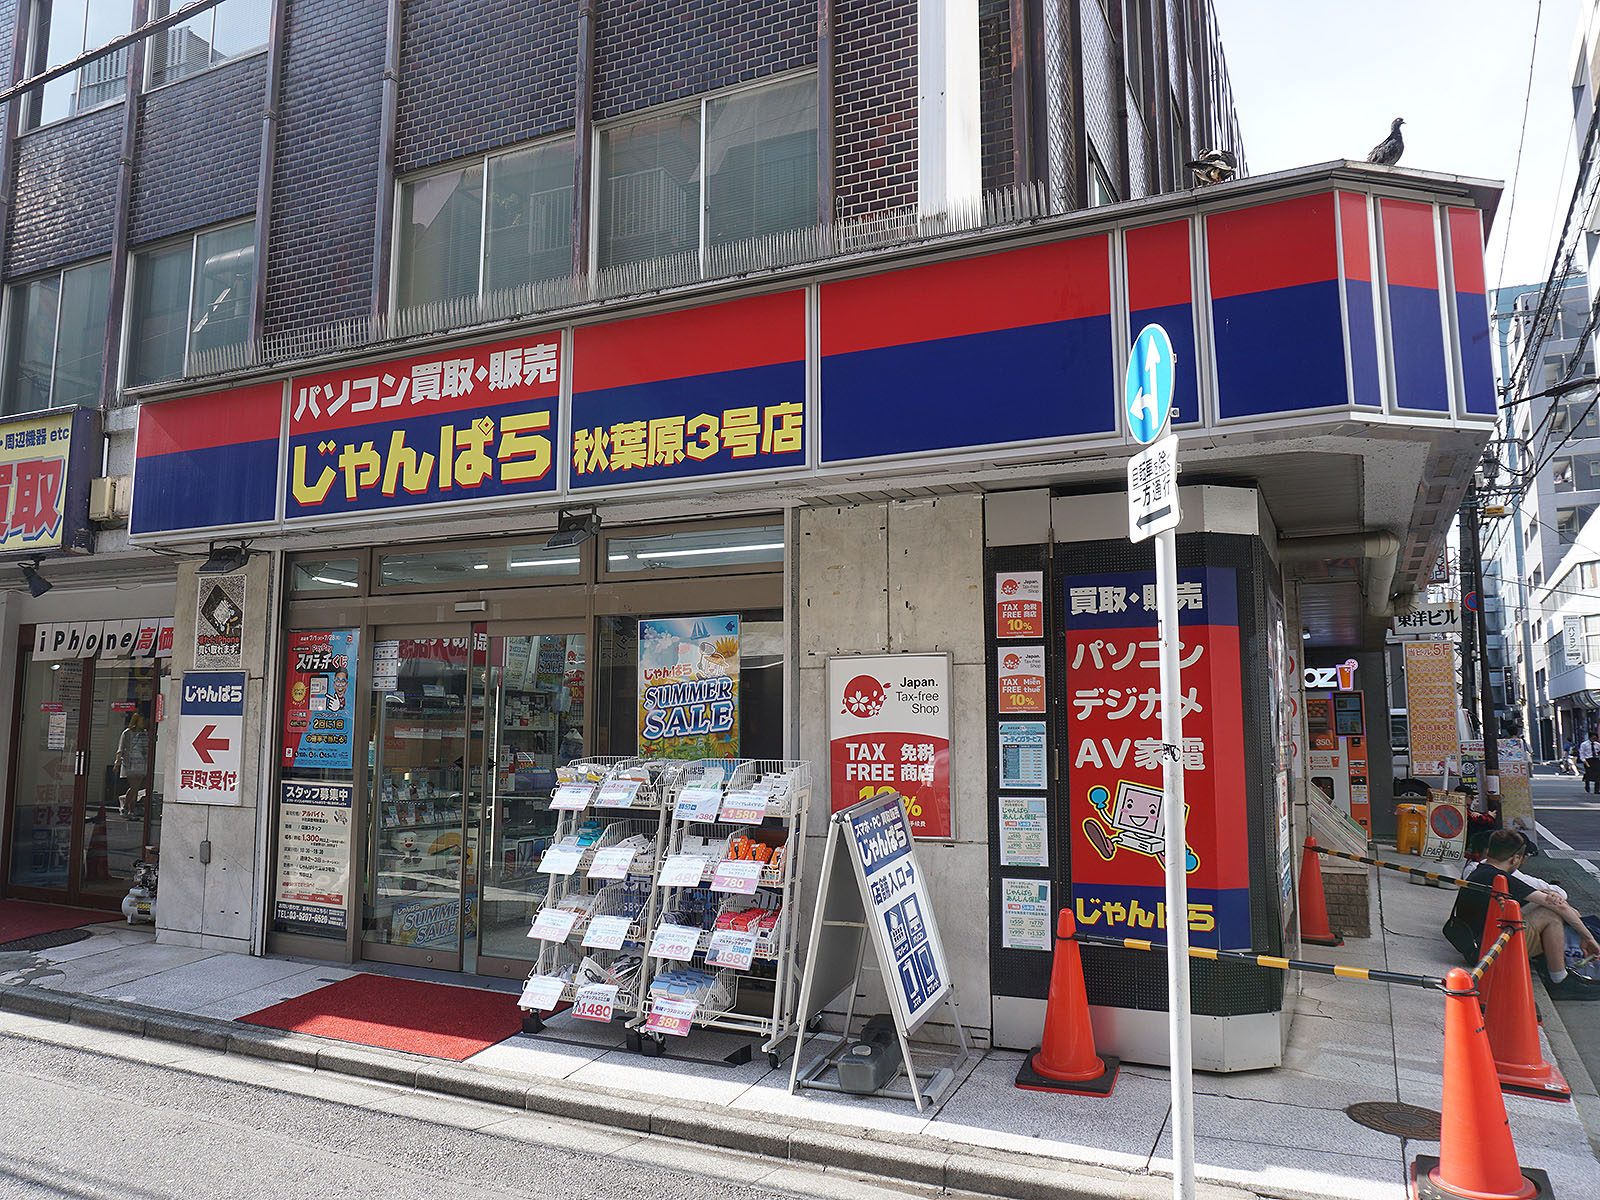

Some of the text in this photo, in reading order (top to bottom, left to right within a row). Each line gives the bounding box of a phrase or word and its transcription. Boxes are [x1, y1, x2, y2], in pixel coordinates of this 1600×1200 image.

[293, 343, 558, 422] パソコン買取・販売
[50, 427, 70, 442] etc
[574, 402, 803, 474] 秋葉原3号店
[292, 410, 551, 506] じゃんぱら
[1133, 473, 1170, 507] 一方通行
[1007, 619, 1032, 631] 10%
[1399, 609, 1458, 627] 東洋ビル
[296, 653, 348, 670] スクラッチくじ
[1071, 639, 1204, 671] パソコン
[644, 664, 692, 680] じゃんぱら
[899, 677, 939, 690] Japan.
[1002, 678, 1018, 686] TAX
[185, 685, 242, 702] じゃんぱら
[644, 677, 734, 710] SUMMER
[896, 691, 940, 702] Tax-free
[1010, 694, 1035, 706] 10%
[911, 703, 940, 716] Shop
[1073, 687, 1203, 720] デジカメ
[643, 701, 735, 740] SALE
[846, 743, 935, 761] TAX 免税
[1075, 737, 1205, 770] AV家電
[181, 769, 237, 791] 買取受付
[846, 763, 935, 782] FREE 商店
[286, 785, 348, 801] スタッフ募集中
[858, 822, 907, 867] じゃんぱら
[871, 868, 906, 906] 店舗入口
[415, 918, 457, 944] SALE
